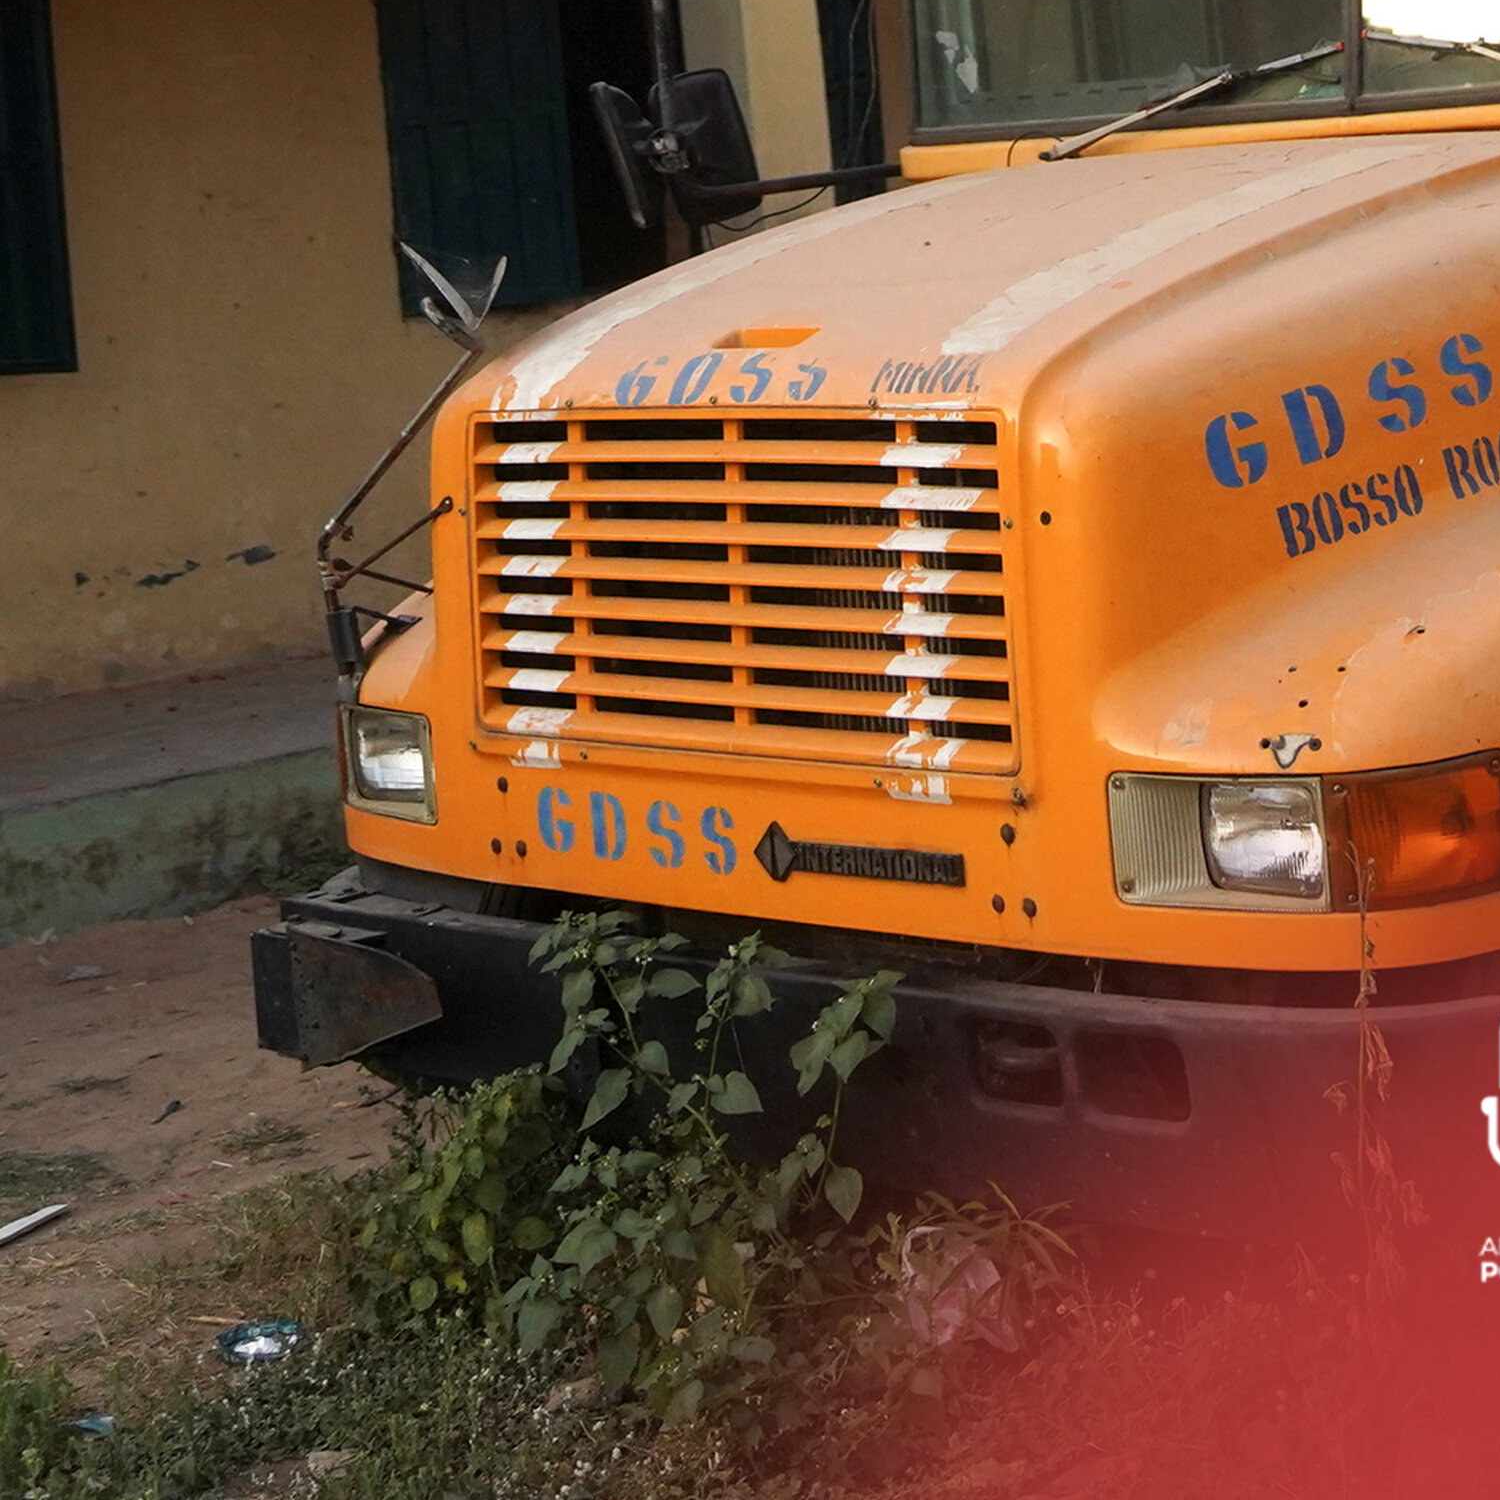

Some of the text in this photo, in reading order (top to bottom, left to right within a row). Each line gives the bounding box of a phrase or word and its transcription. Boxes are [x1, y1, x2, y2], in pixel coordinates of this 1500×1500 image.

[613, 352, 828, 408] GDSS
[1205, 333, 1493, 488] GDSS
[1276, 464, 1424, 559] BOSSO
[537, 786, 738, 876] GDSS
[798, 843, 960, 884] INTERNATIONAL
